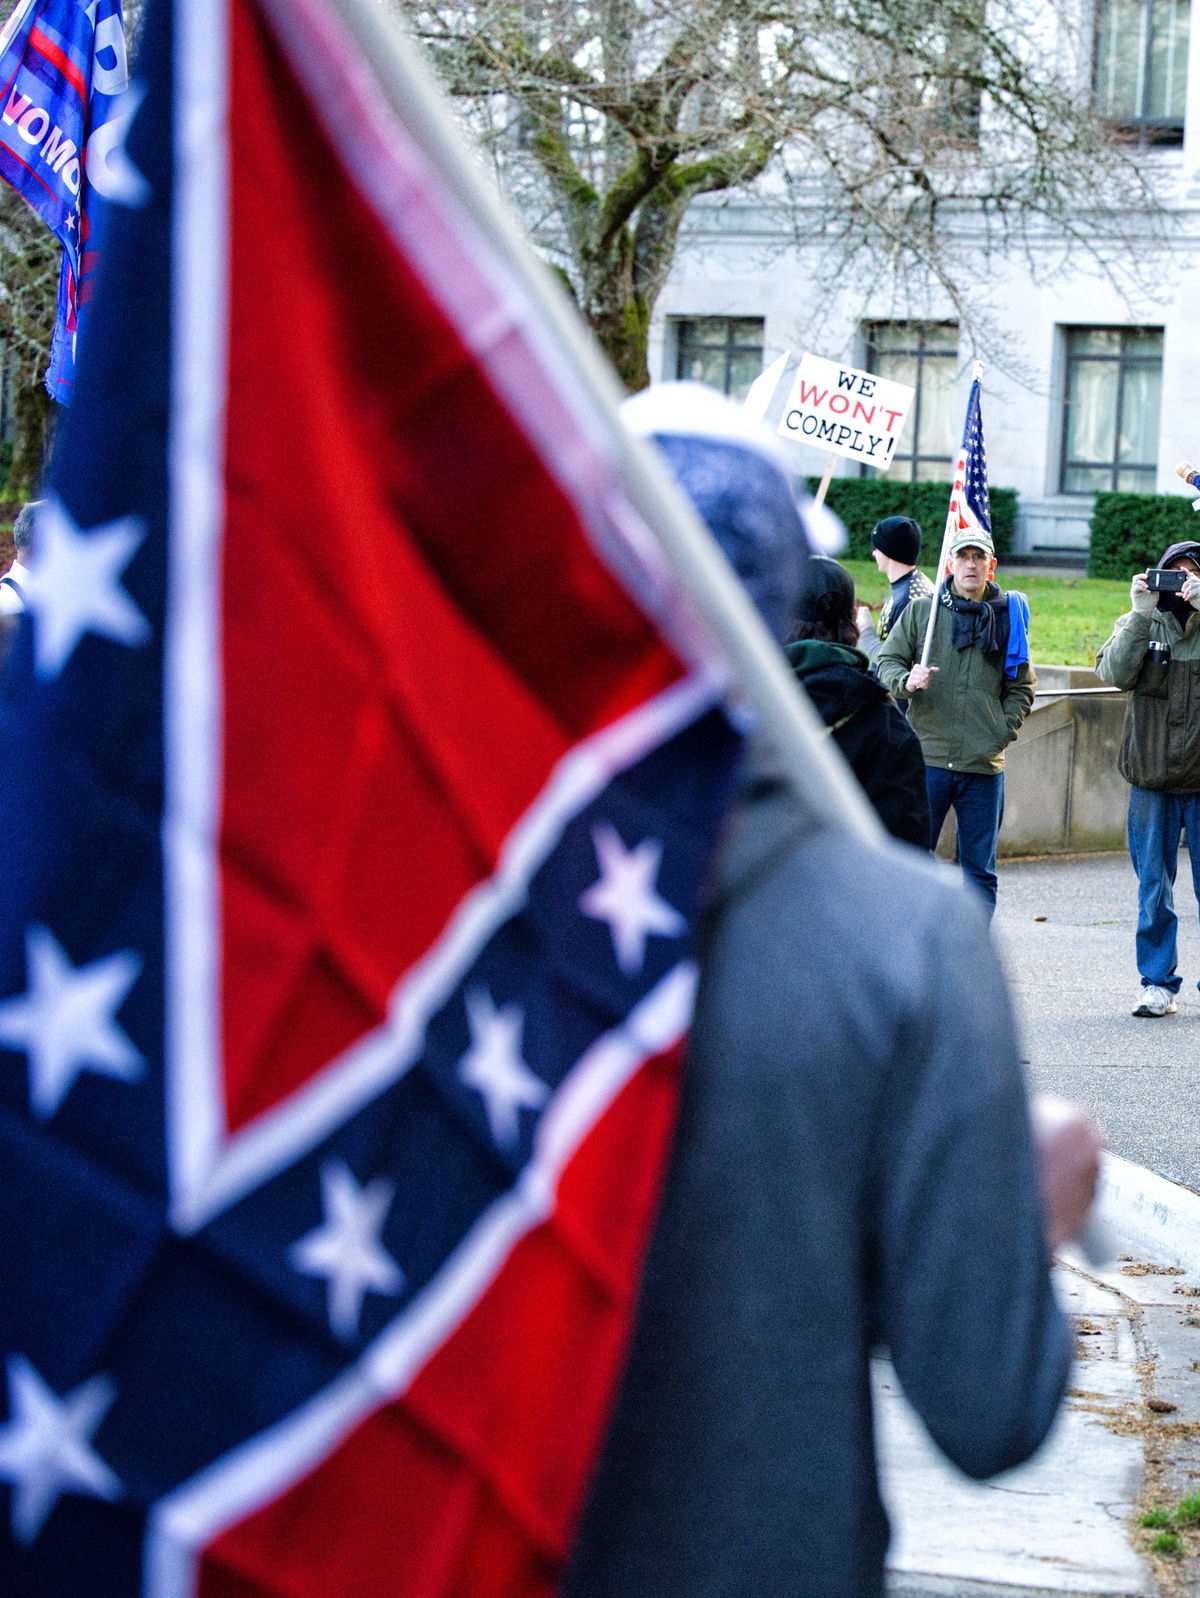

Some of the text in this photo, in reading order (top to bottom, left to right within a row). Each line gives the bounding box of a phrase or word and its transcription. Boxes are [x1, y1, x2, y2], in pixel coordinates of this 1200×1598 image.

[39, 125, 81, 195] MO
[801, 380, 903, 432] WON'T
[837, 371, 877, 398] WE
[786, 410, 894, 461] COMPLY!
